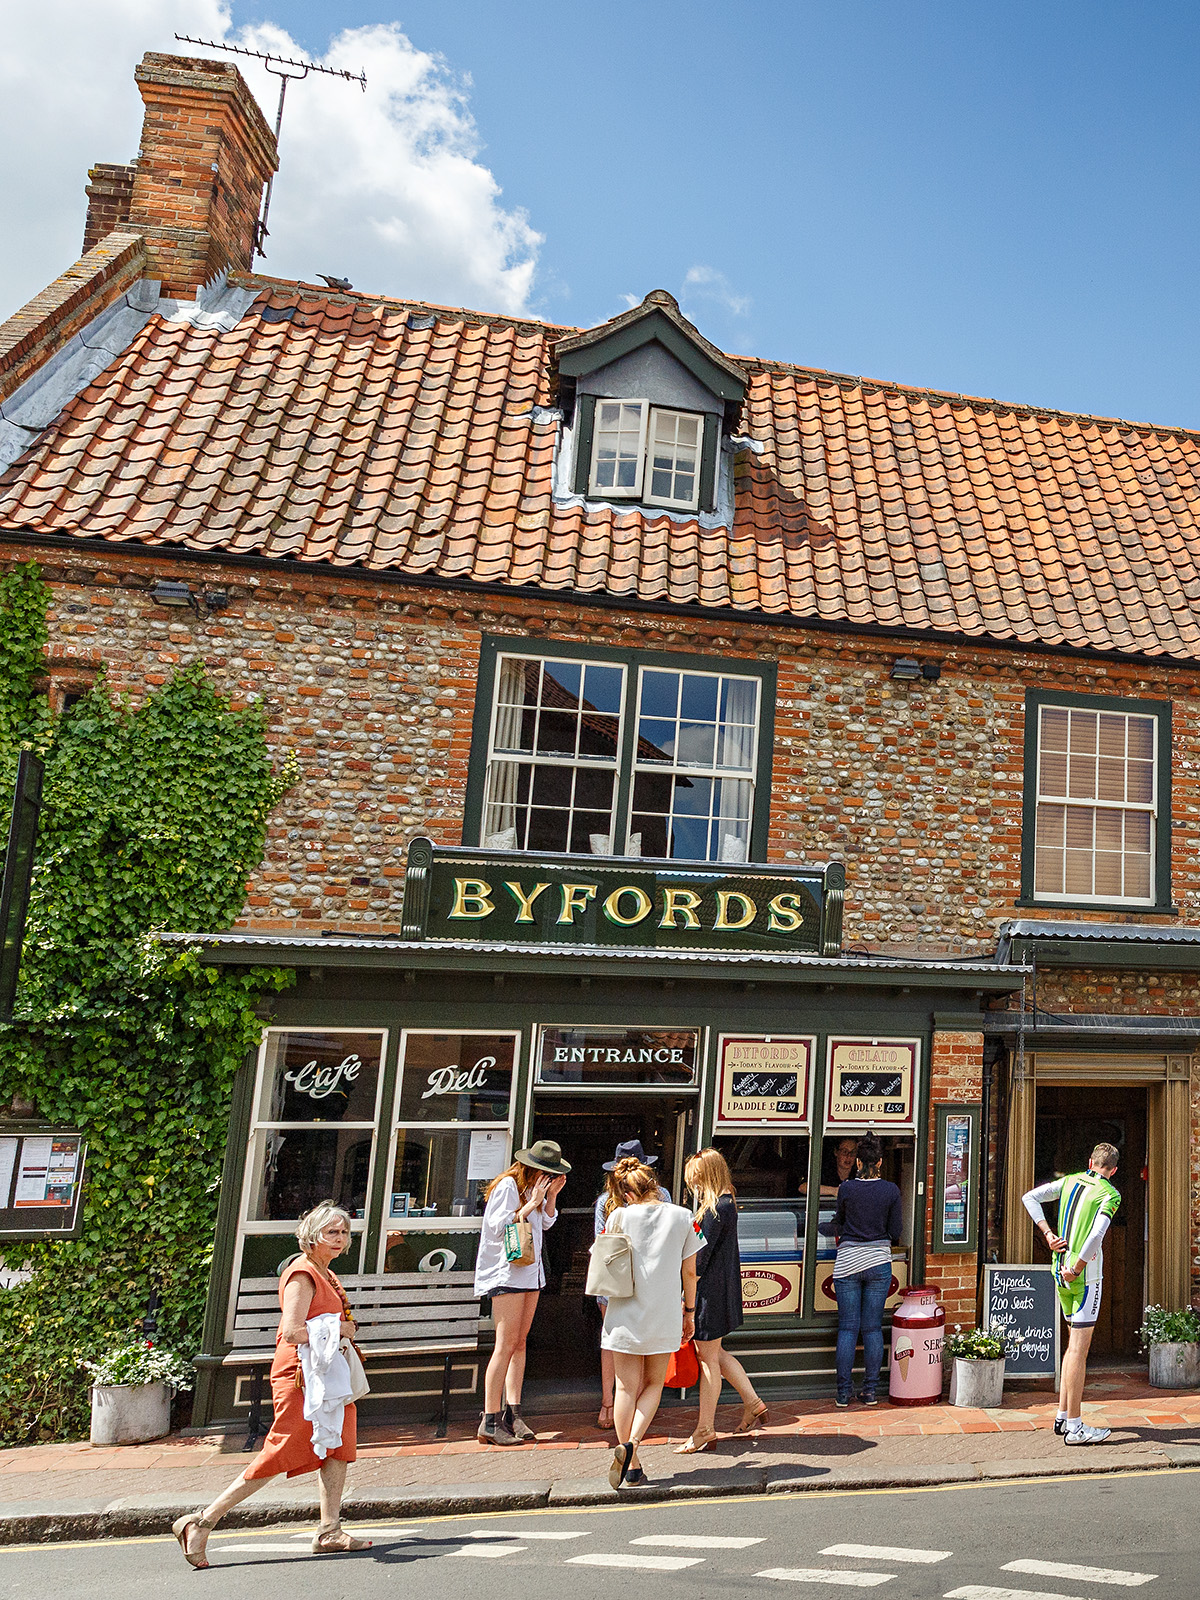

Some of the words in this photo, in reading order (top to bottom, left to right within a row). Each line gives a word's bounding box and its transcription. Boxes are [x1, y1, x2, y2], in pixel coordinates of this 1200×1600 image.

[447, 877, 804, 933] BYFORDS
[553, 1047, 684, 1064] ENTRANCE
[733, 1047, 799, 1060] BYFORDS
[848, 1050, 898, 1062] GELATO
[420, 1056, 497, 1100] Deli
[733, 1102, 767, 1111] PADDLE
[769, 1102, 776, 1111] £
[834, 1104, 841, 1112] 2
[843, 1104, 875, 1112] PADDLE
[876, 1104, 883, 1112] £
[755, 1272, 776, 1280] MADE
[760, 1295, 781, 1306] GEOFF
[991, 1295, 1008, 1311] 200
[1024, 1326, 1053, 1339] drinks
[1004, 1341, 1020, 1361] day
[1021, 1341, 1050, 1361] everyday
